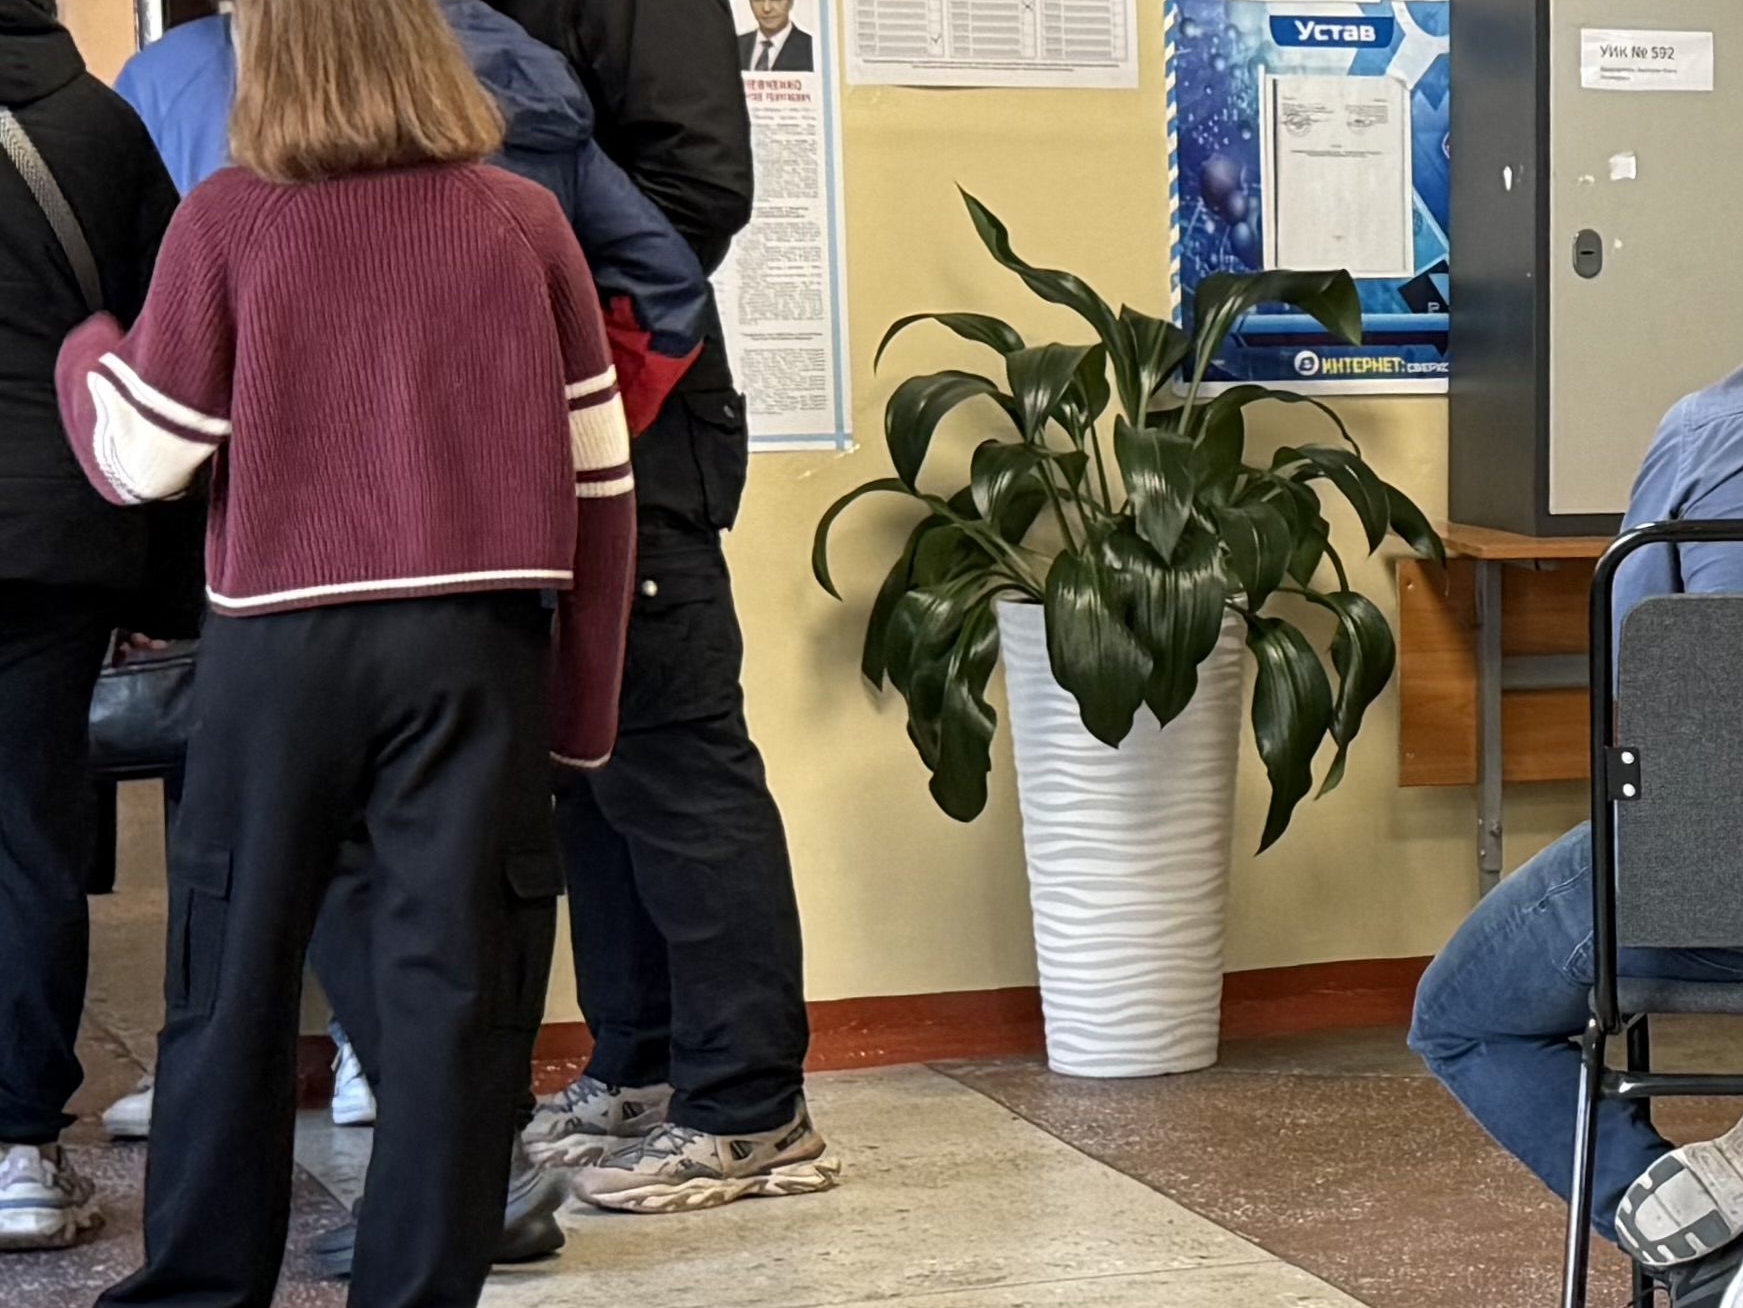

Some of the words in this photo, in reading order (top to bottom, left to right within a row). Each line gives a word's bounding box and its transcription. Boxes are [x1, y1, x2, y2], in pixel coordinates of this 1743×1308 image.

[1294, 19, 1377, 42] Устав
[1599, 44, 1628, 59] УИК
[1631, 45, 1648, 60] №
[1651, 46, 1675, 60] 592
[1322, 355, 1406, 375] ИНТЕРНЕТ:
